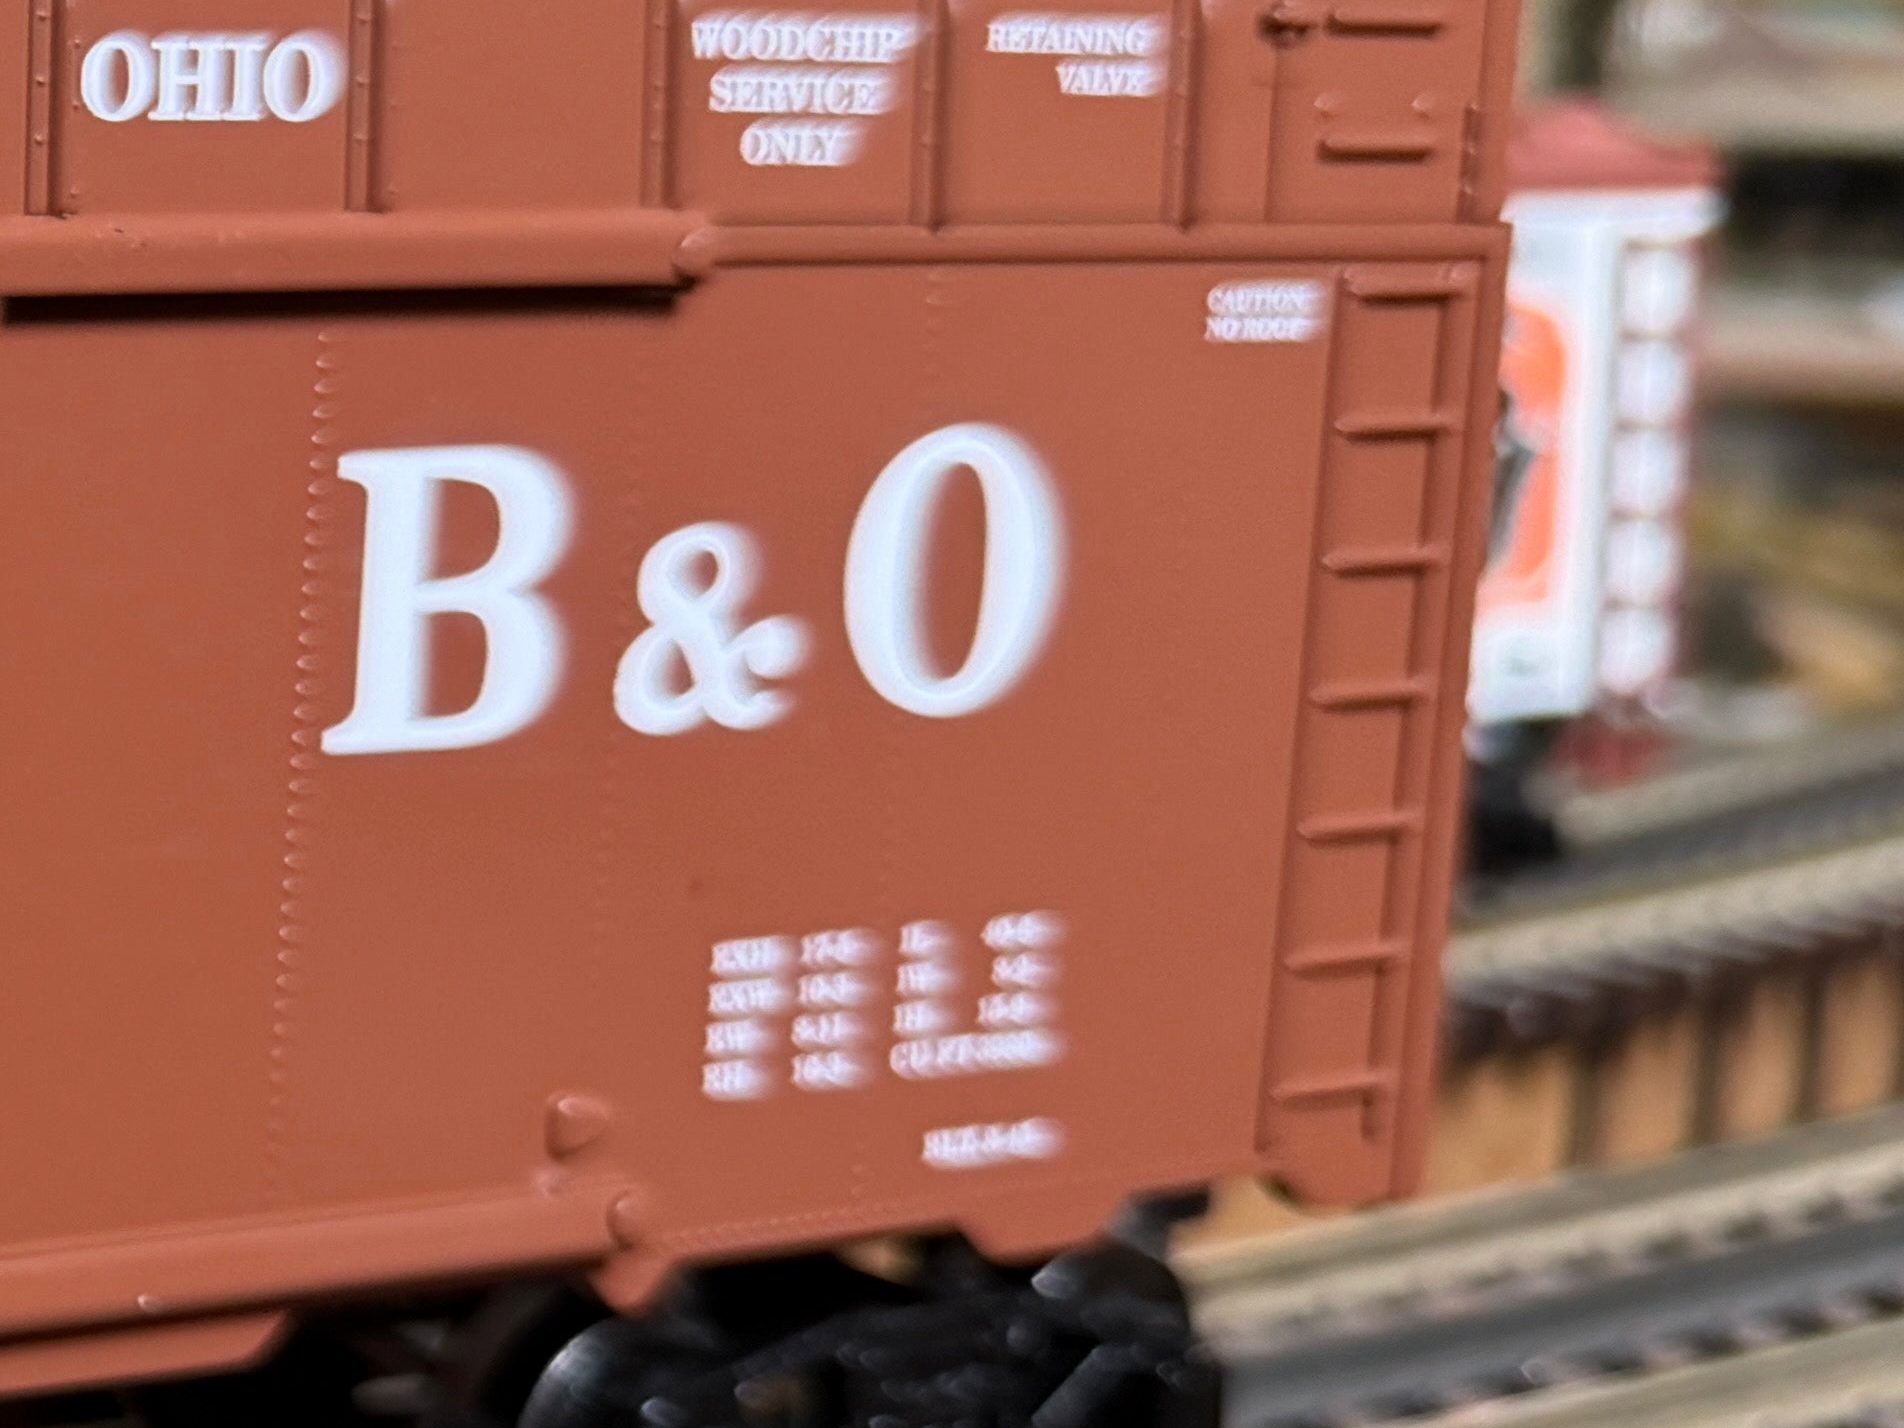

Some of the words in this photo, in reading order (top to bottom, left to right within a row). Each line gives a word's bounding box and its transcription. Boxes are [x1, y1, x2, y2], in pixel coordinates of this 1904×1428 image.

[691, 10, 916, 64] WOODCHIP
[986, 13, 1166, 56] RETAINING
[81, 31, 346, 122] OHIO
[709, 66, 896, 115] SERVICE
[1056, 60, 1166, 97] VALVE
[740, 120, 863, 166] ONLY
